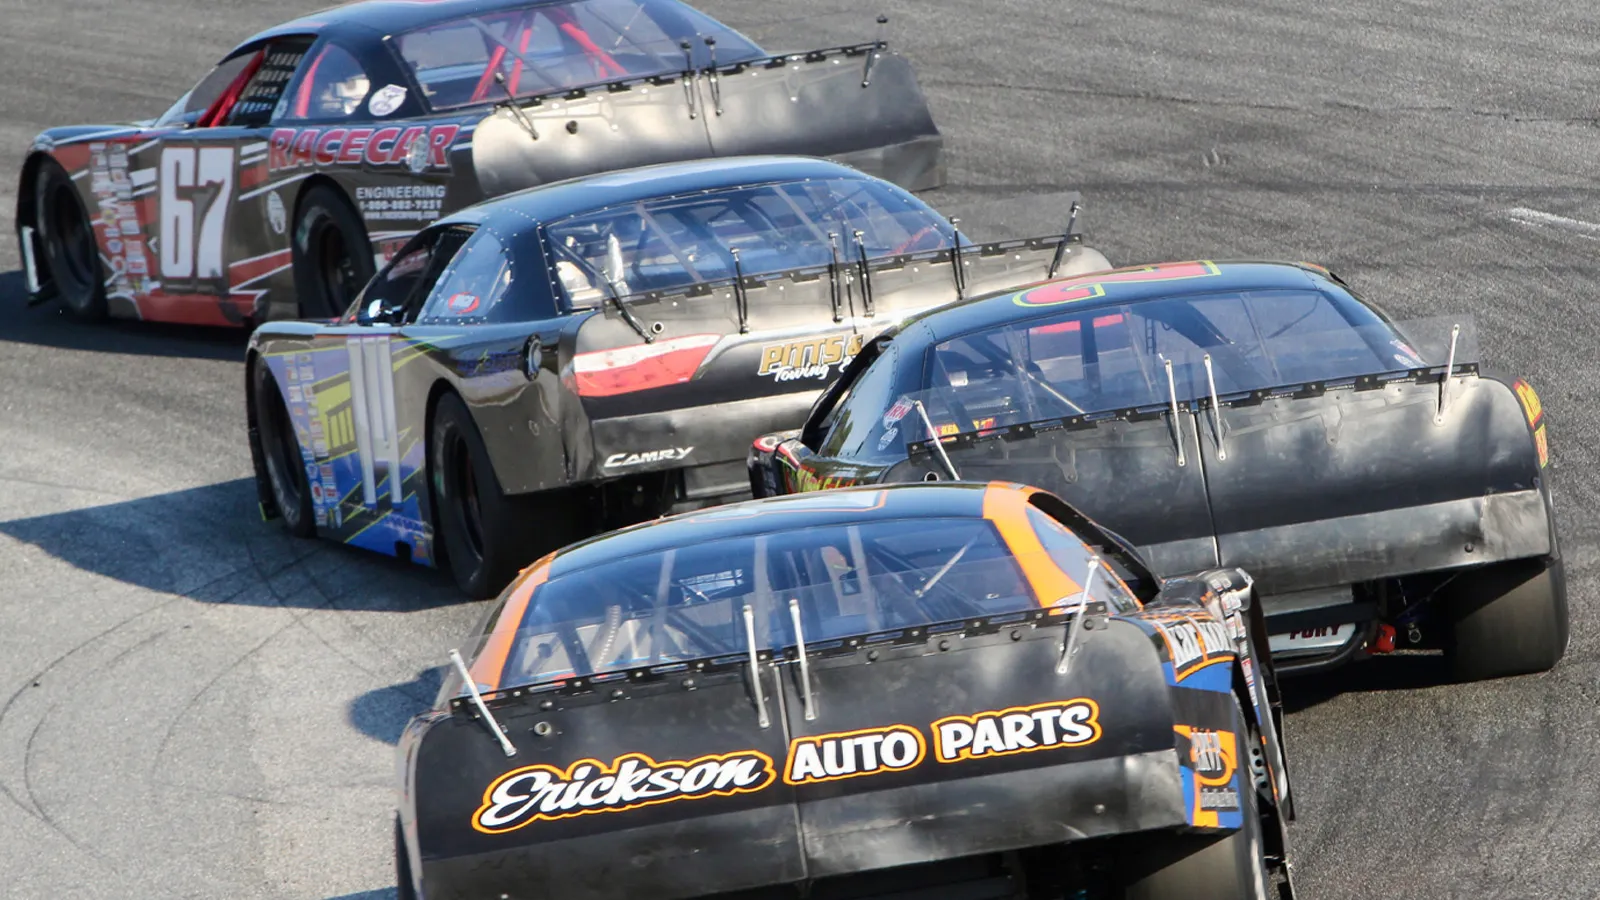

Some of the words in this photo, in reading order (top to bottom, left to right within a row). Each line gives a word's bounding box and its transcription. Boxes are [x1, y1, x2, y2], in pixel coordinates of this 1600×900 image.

[269, 125, 459, 171] RACECAR
[161, 147, 234, 278] 67
[356, 185, 446, 199] ENGINEERING
[757, 335, 847, 376] PITTS
[774, 362, 830, 382] Towing
[603, 446, 695, 468] CAMRY
[480, 758, 762, 827] Erickson
[791, 731, 919, 780] AUTO
[940, 705, 1092, 759] PARTS
